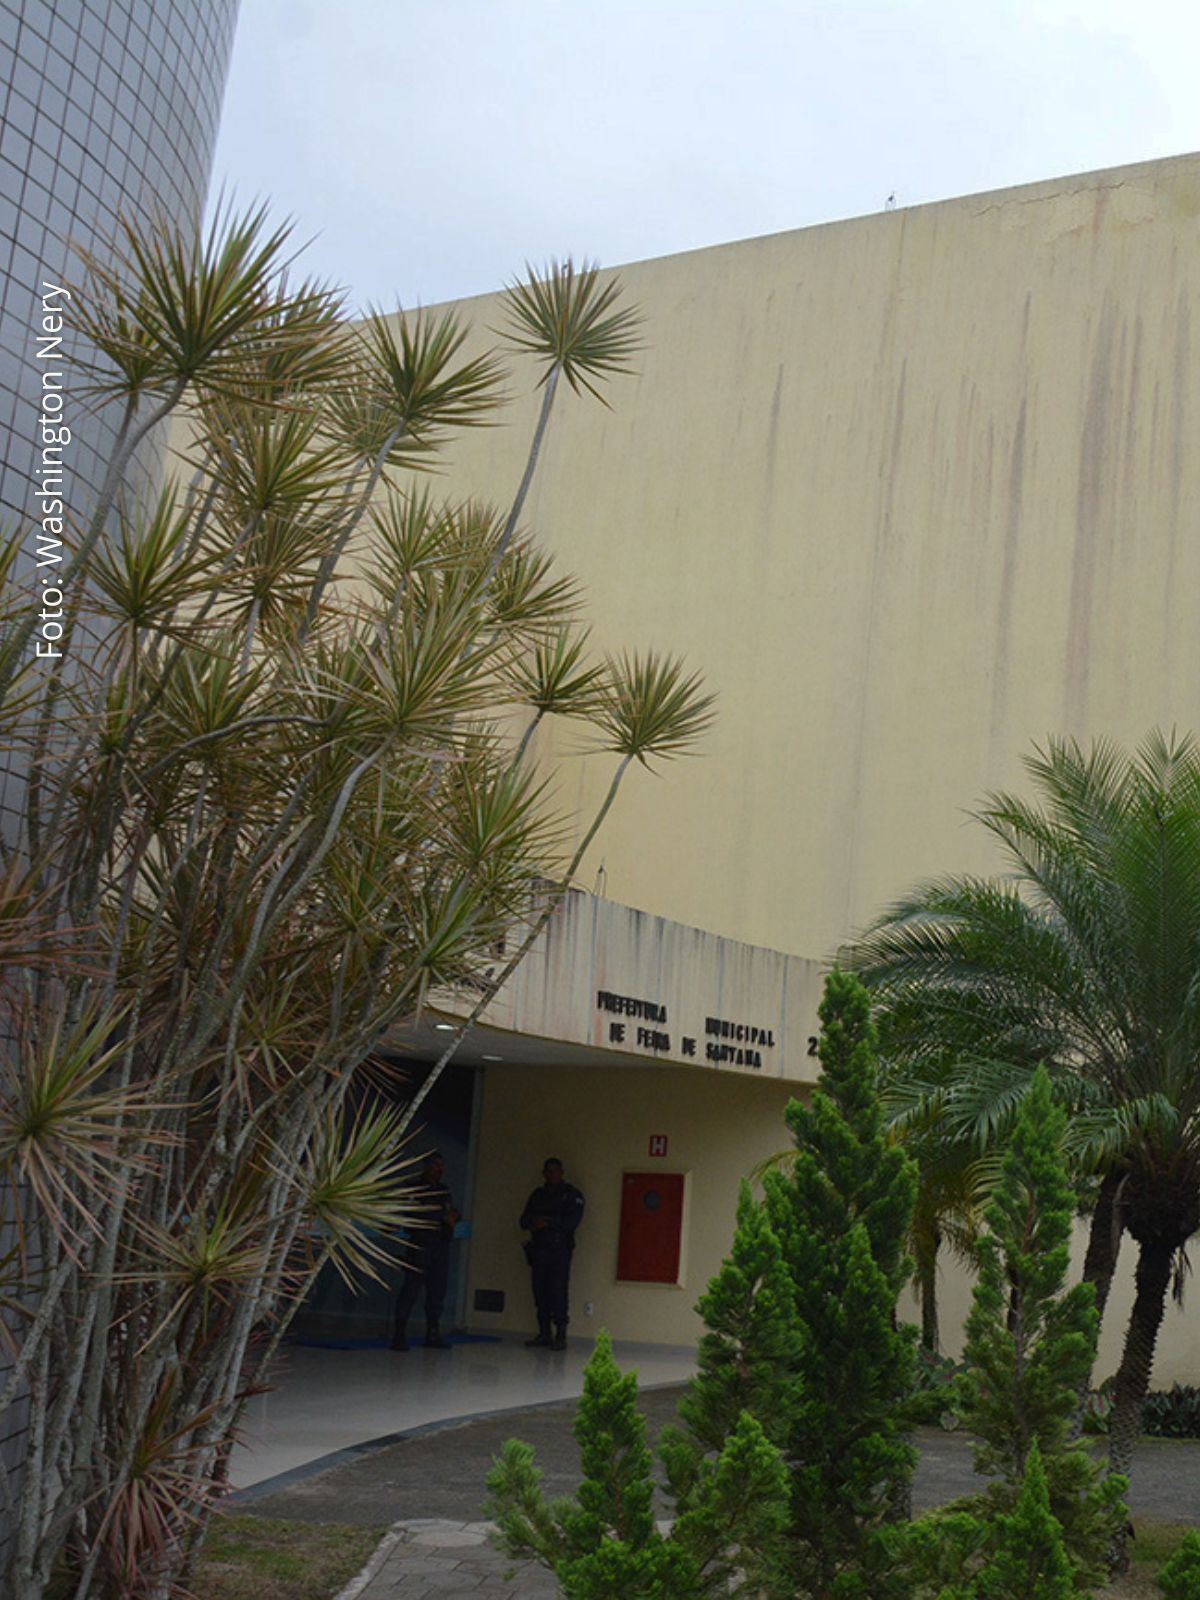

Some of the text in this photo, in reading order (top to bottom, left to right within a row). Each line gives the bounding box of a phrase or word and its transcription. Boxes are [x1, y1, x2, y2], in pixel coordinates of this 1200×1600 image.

[597, 990, 775, 1047] PREFEITURA MUNICIPAL
[706, 1042, 761, 1068] SANTANA
[652, 1137, 664, 1154] H
